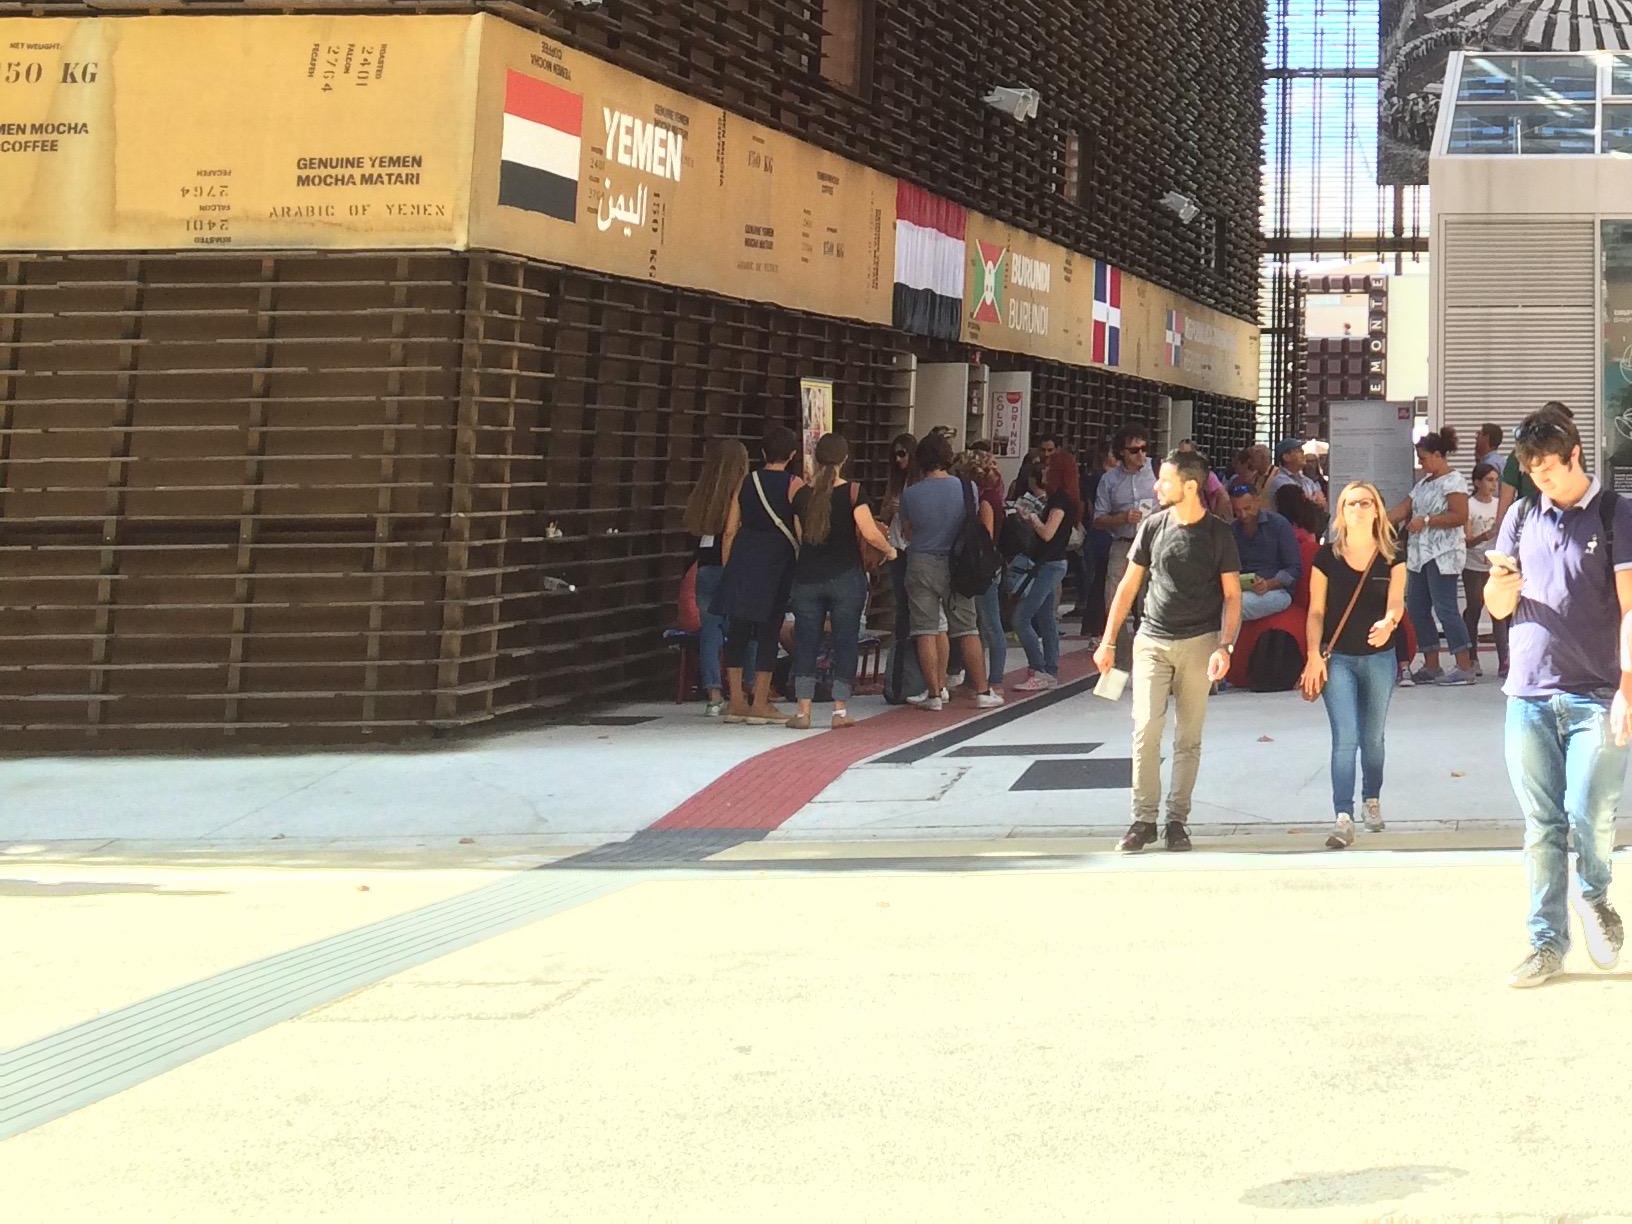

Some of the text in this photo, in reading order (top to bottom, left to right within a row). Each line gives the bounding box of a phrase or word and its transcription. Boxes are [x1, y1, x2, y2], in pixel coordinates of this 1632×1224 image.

[321, 45, 340, 92] 2764
[343, 43, 355, 74] FALCON
[355, 46, 374, 86] 2401
[375, 43, 388, 79] ROASTED
[60, 61, 99, 84] KG
[30, 122, 89, 135] MOCHA
[1, 139, 59, 153] COFFEE
[603, 106, 683, 183] YEMEN
[297, 155, 423, 171] GENUINE YEMEN
[180, 185, 229, 198] 2764
[296, 172, 421, 188] MOCHA MATARI
[199, 204, 231, 212] FALCON
[349, 203, 371, 217] OF
[386, 202, 446, 217] YEMEN
[597, 177, 648, 237] اليمن
[186, 219, 229, 231] 2401
[193, 236, 232, 244] ROASTED
[1011, 252, 1051, 293] BURUNDI
[1008, 297, 1049, 336] BURUNDI
[996, 395, 1005, 428] COLD
[1010, 406, 1019, 455] DRINKS
